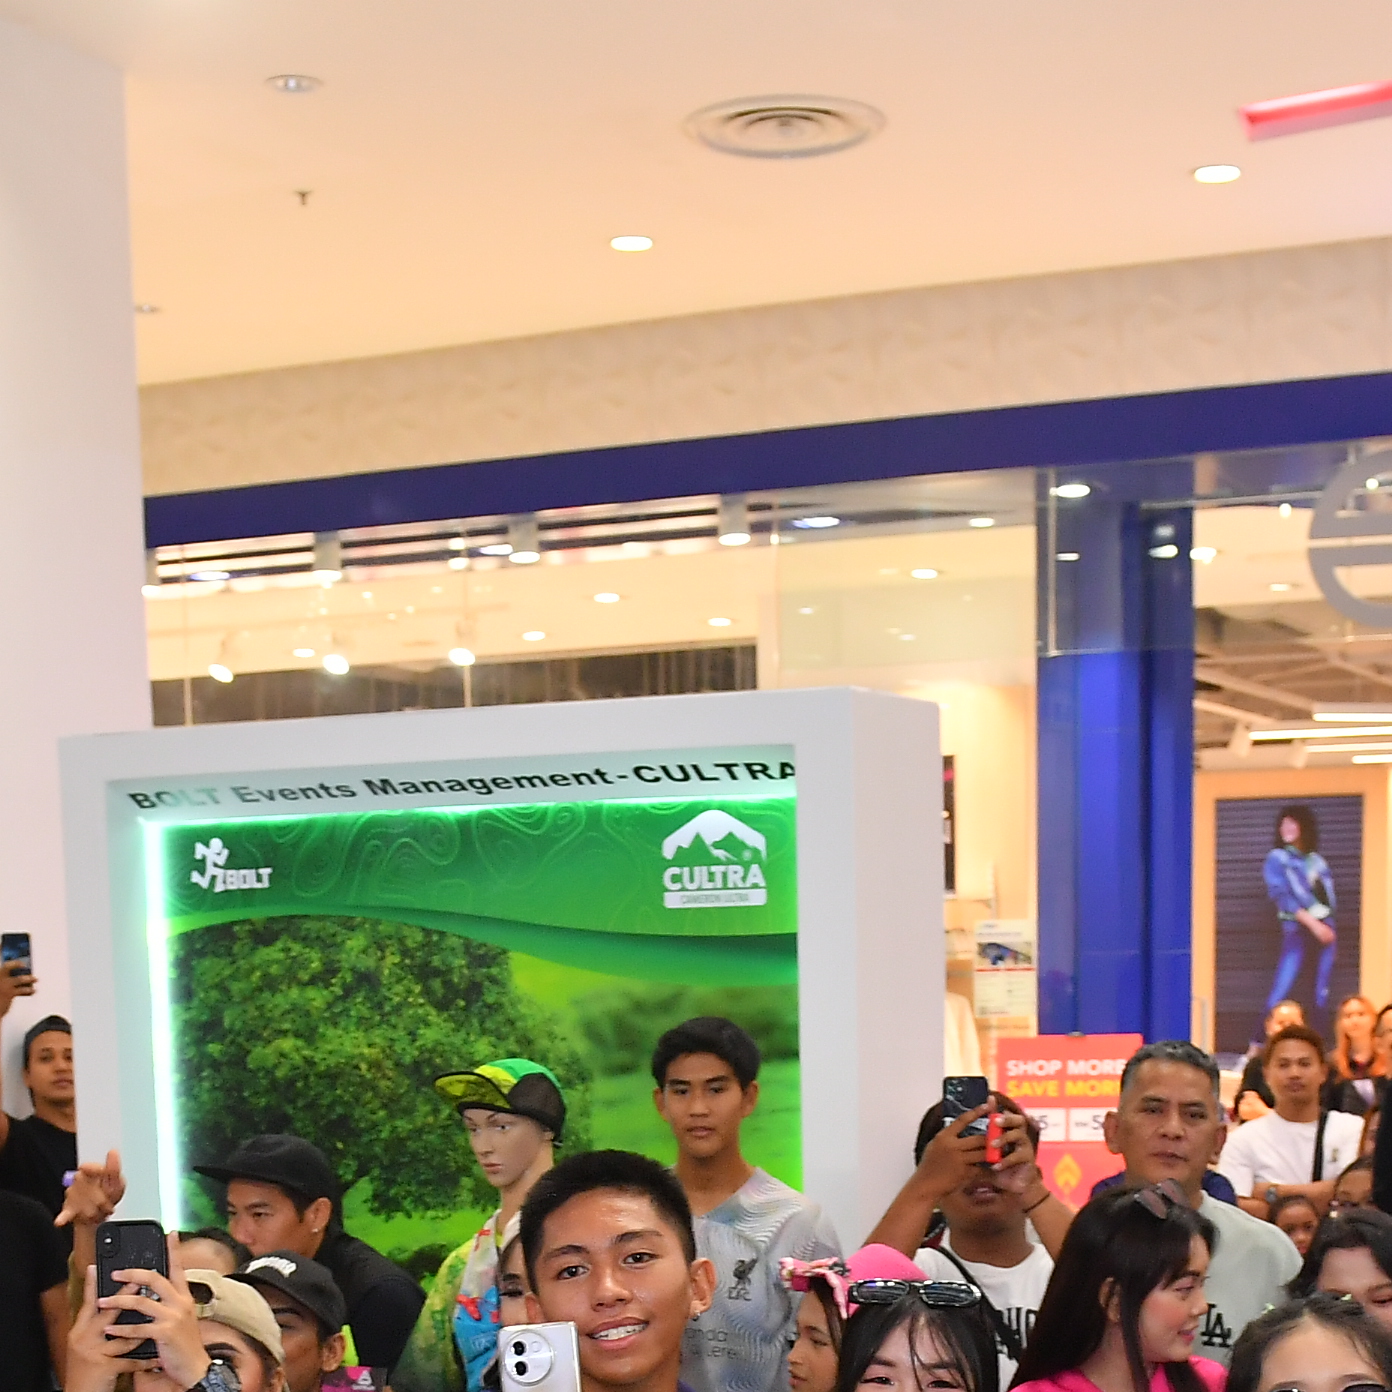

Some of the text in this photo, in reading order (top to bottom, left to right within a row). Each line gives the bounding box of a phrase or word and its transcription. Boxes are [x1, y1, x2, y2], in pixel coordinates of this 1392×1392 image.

[127, 786, 220, 810] BOLT
[231, 781, 358, 804] Events
[662, 863, 767, 891] CULTRA
[1007, 1058, 1127, 1077] SHOP MORE
[1008, 1080, 1059, 1097] SAVE
